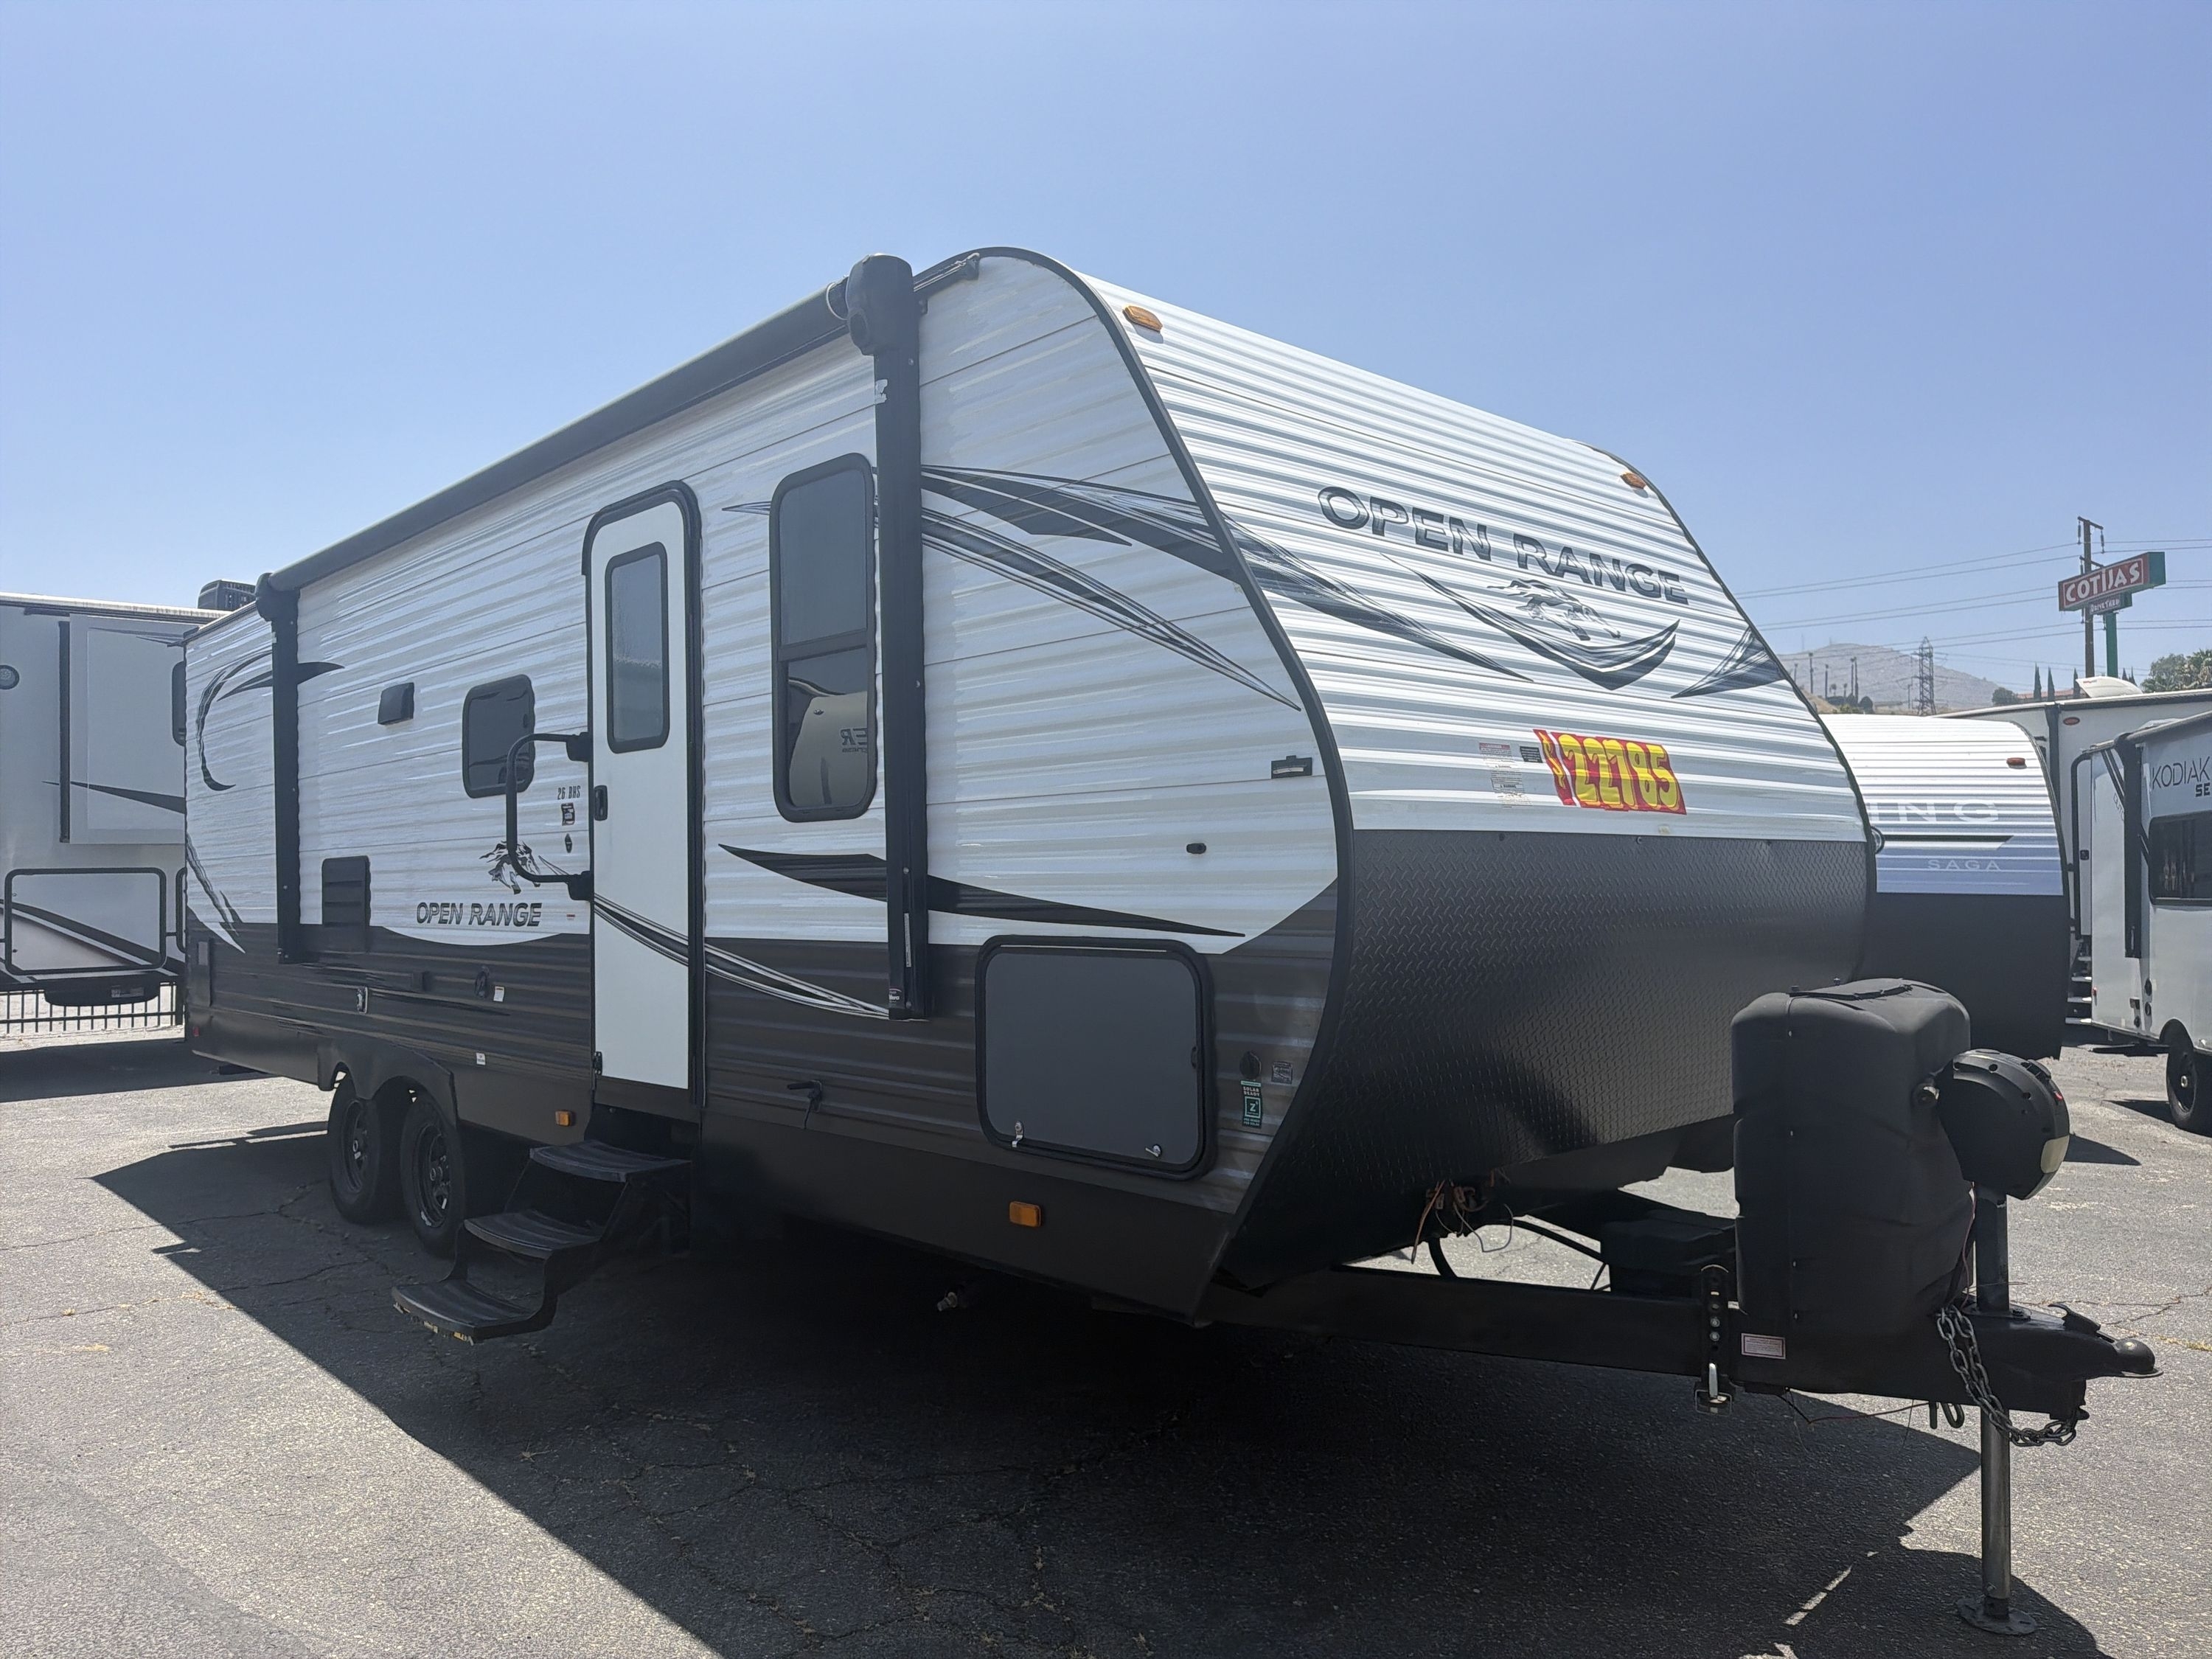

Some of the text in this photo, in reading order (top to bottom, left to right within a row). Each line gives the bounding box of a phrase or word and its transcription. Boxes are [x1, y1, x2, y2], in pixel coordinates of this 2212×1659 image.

[1318, 485, 1689, 605] OPEN RANGE
[2065, 562, 2140, 602] COTIJAS
[2152, 756, 2211, 790] KODIAK
[557, 785, 581, 800] 26 BHS
[2195, 782, 2211, 797] SE
[1927, 859, 2001, 871] SAGA
[416, 902, 543, 928] OPEN RANGE
